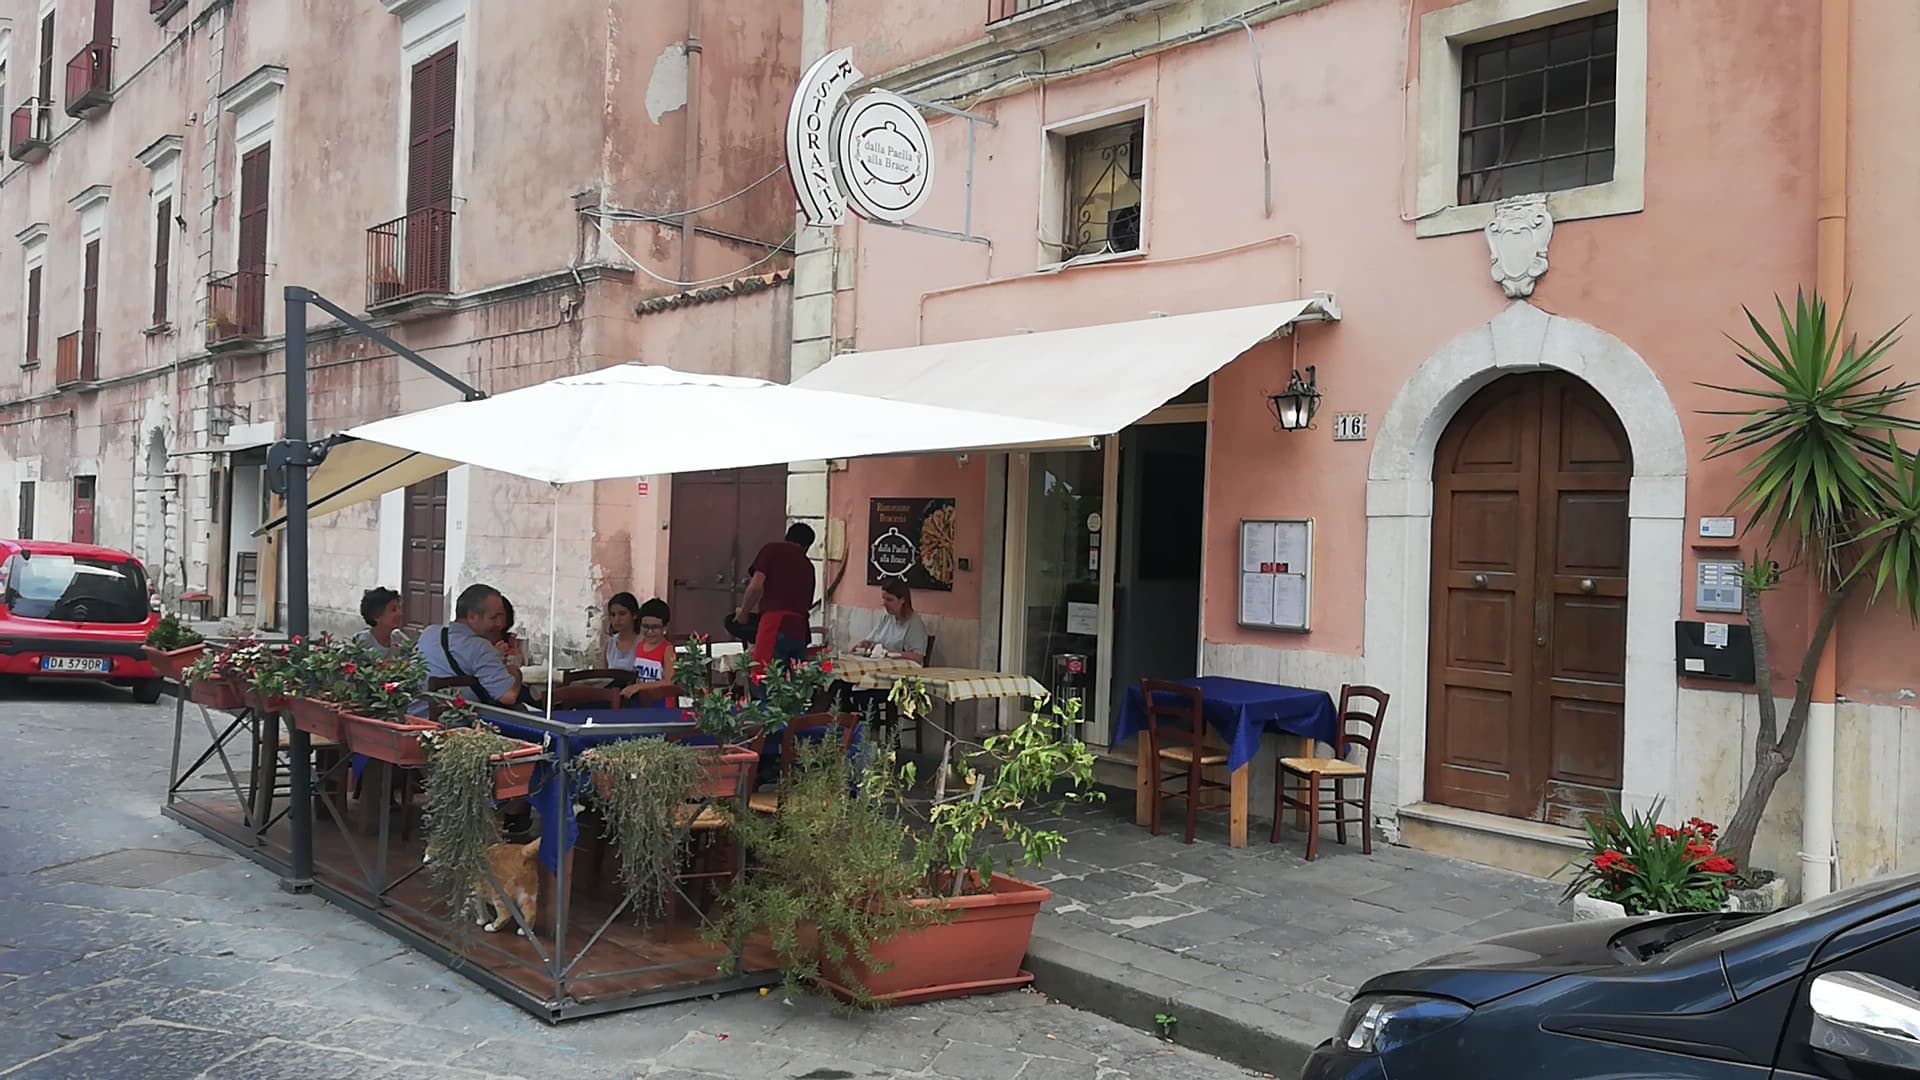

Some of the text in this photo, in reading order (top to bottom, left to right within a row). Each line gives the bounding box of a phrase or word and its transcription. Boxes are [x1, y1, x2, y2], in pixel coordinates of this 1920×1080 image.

[807, 59, 853, 220] RISTORANTE
[864, 140, 913, 162] dalla Paella
[866, 154, 909, 173] alla Brace
[1341, 417, 1360, 436] 16
[50, 658, 102, 670] DA 379DR
